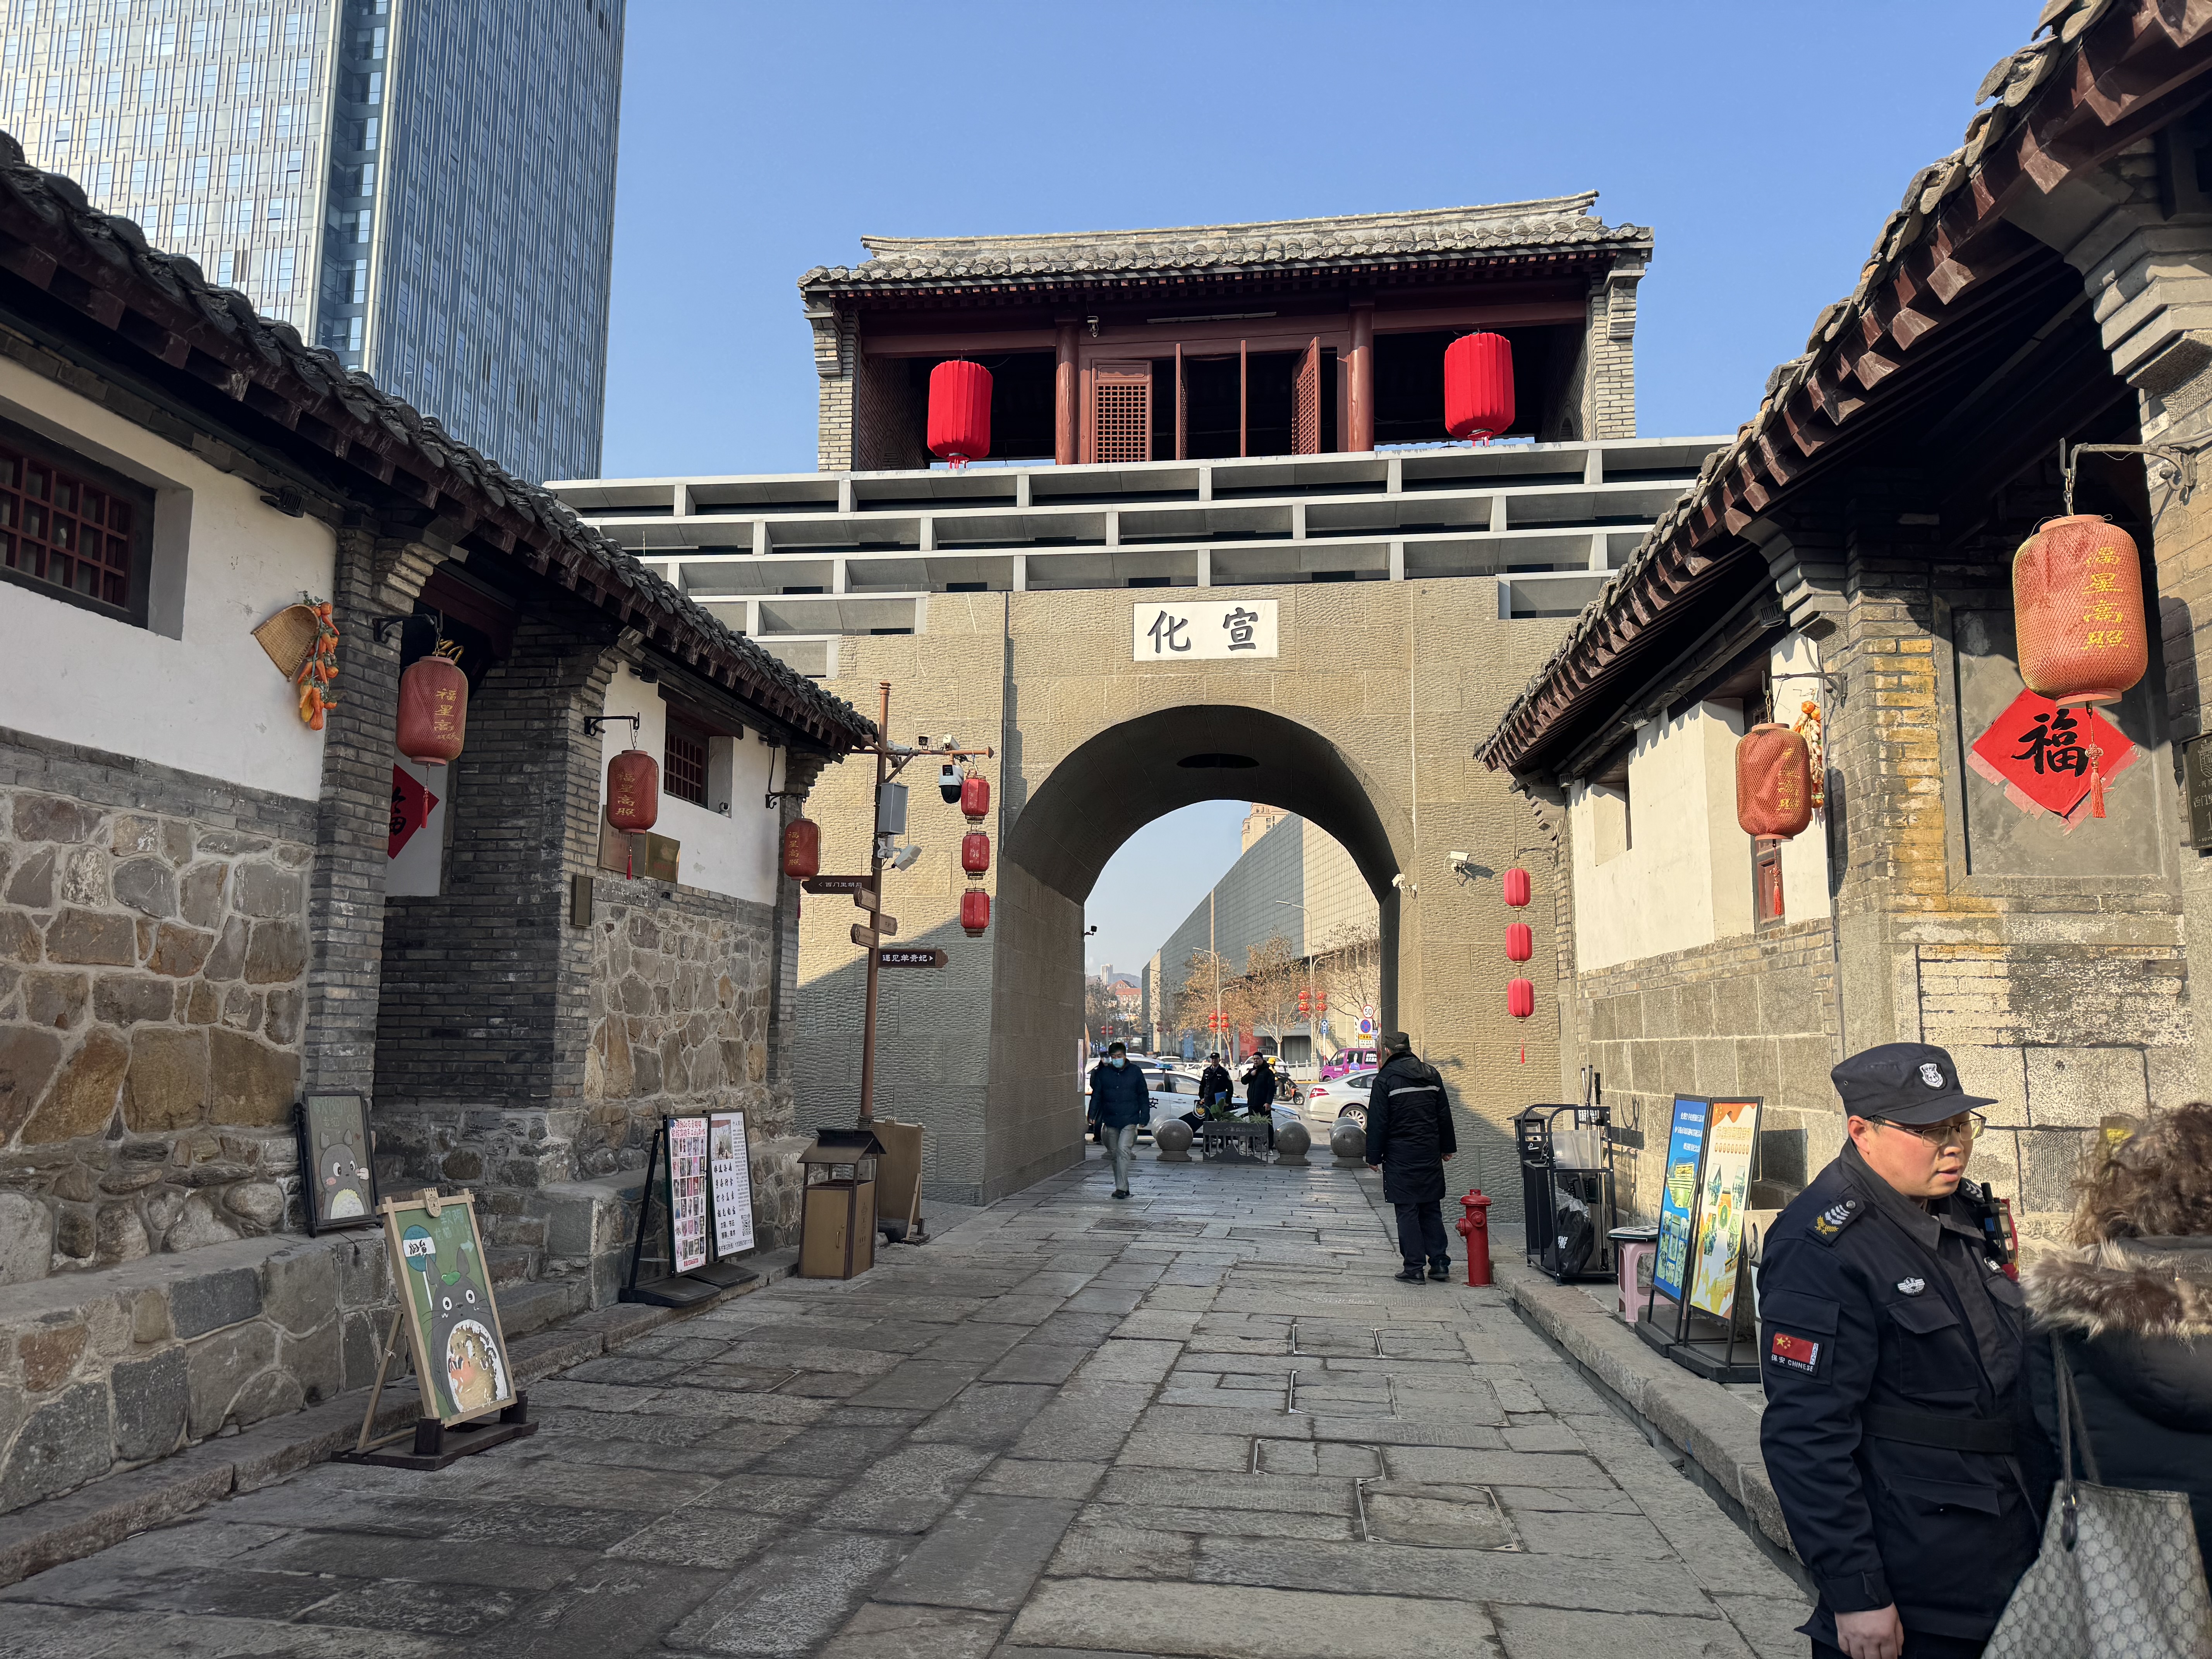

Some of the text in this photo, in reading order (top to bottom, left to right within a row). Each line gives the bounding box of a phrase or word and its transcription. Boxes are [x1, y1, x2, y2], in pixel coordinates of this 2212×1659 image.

[2080, 546, 2129, 650] 福星高照
[2011, 708, 2089, 777] 福
[615, 771, 635, 817] 福星高照
[788, 831, 801, 866] 福星高照
[1149, 1097, 1159, 1109] 安
[1771, 1354, 1814, 1372] 保安 CHINESE
